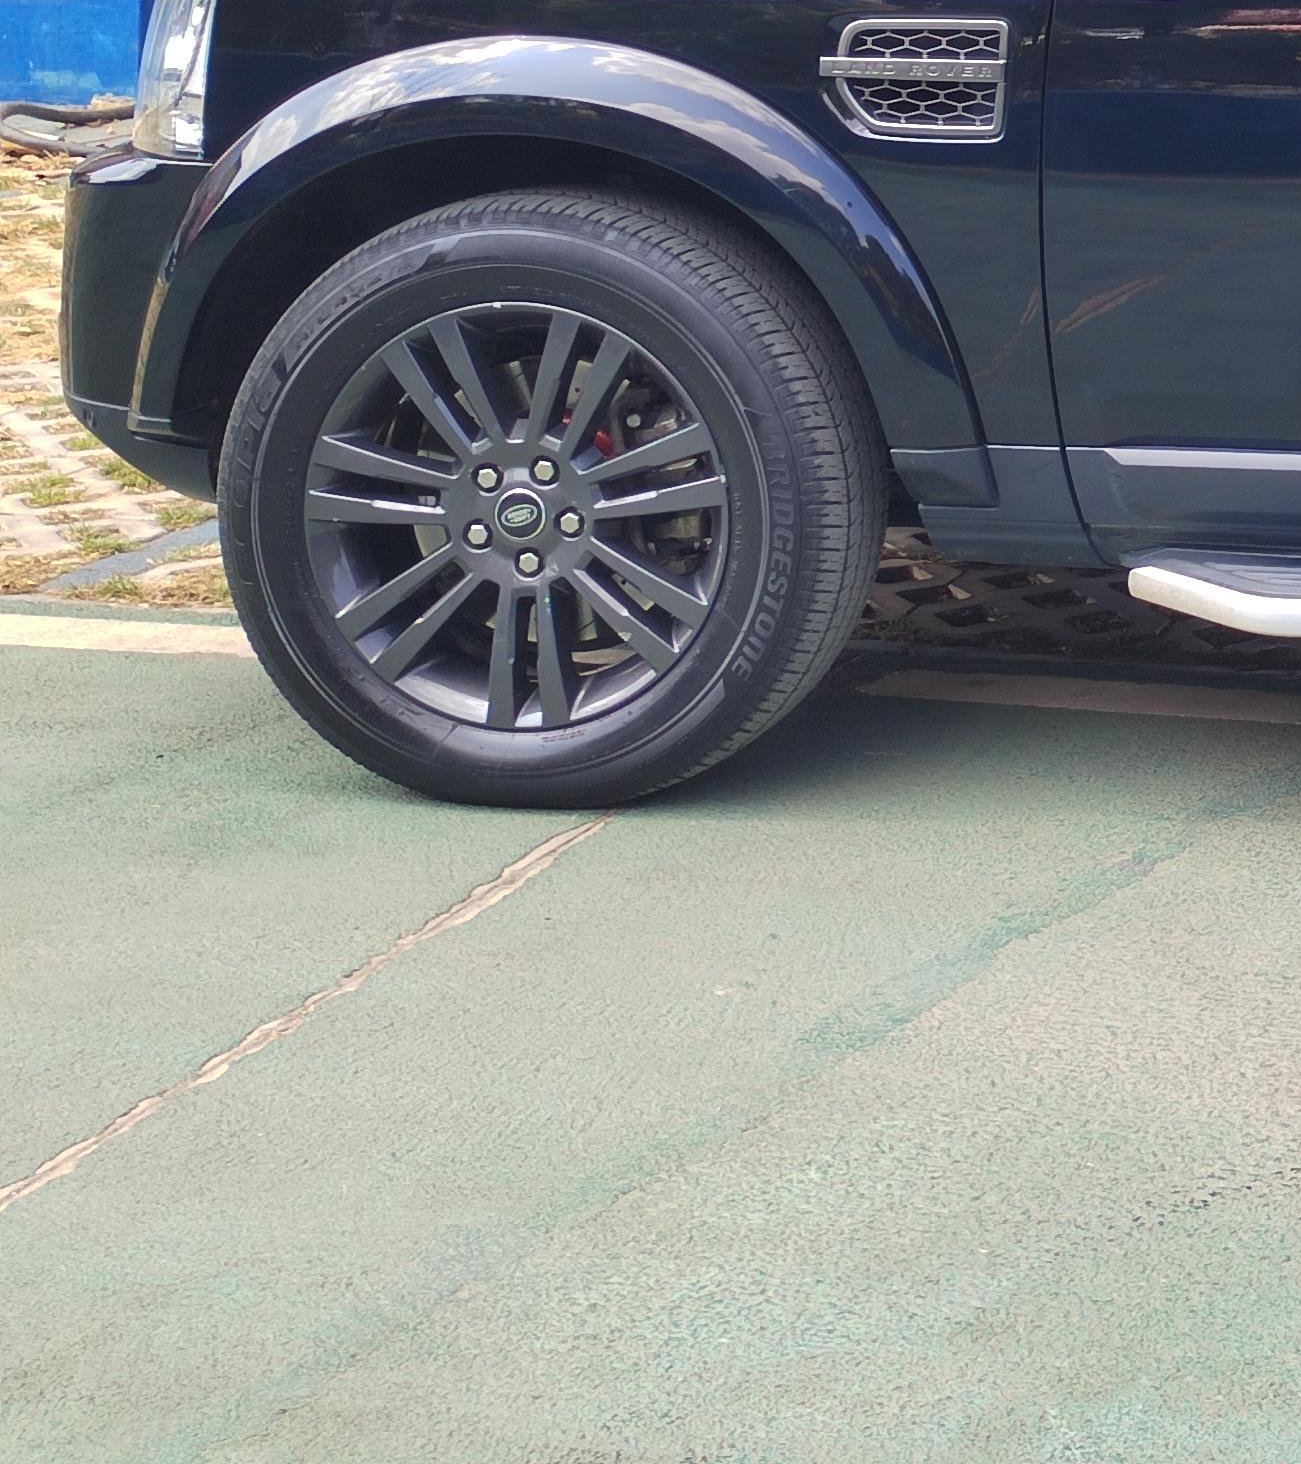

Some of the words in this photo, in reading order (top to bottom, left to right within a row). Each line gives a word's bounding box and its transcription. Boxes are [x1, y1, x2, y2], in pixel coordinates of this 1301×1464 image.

[831, 61, 897, 75] LAND
[909, 64, 994, 78] ROVER
[731, 440, 796, 682] BRIDGESTONE
